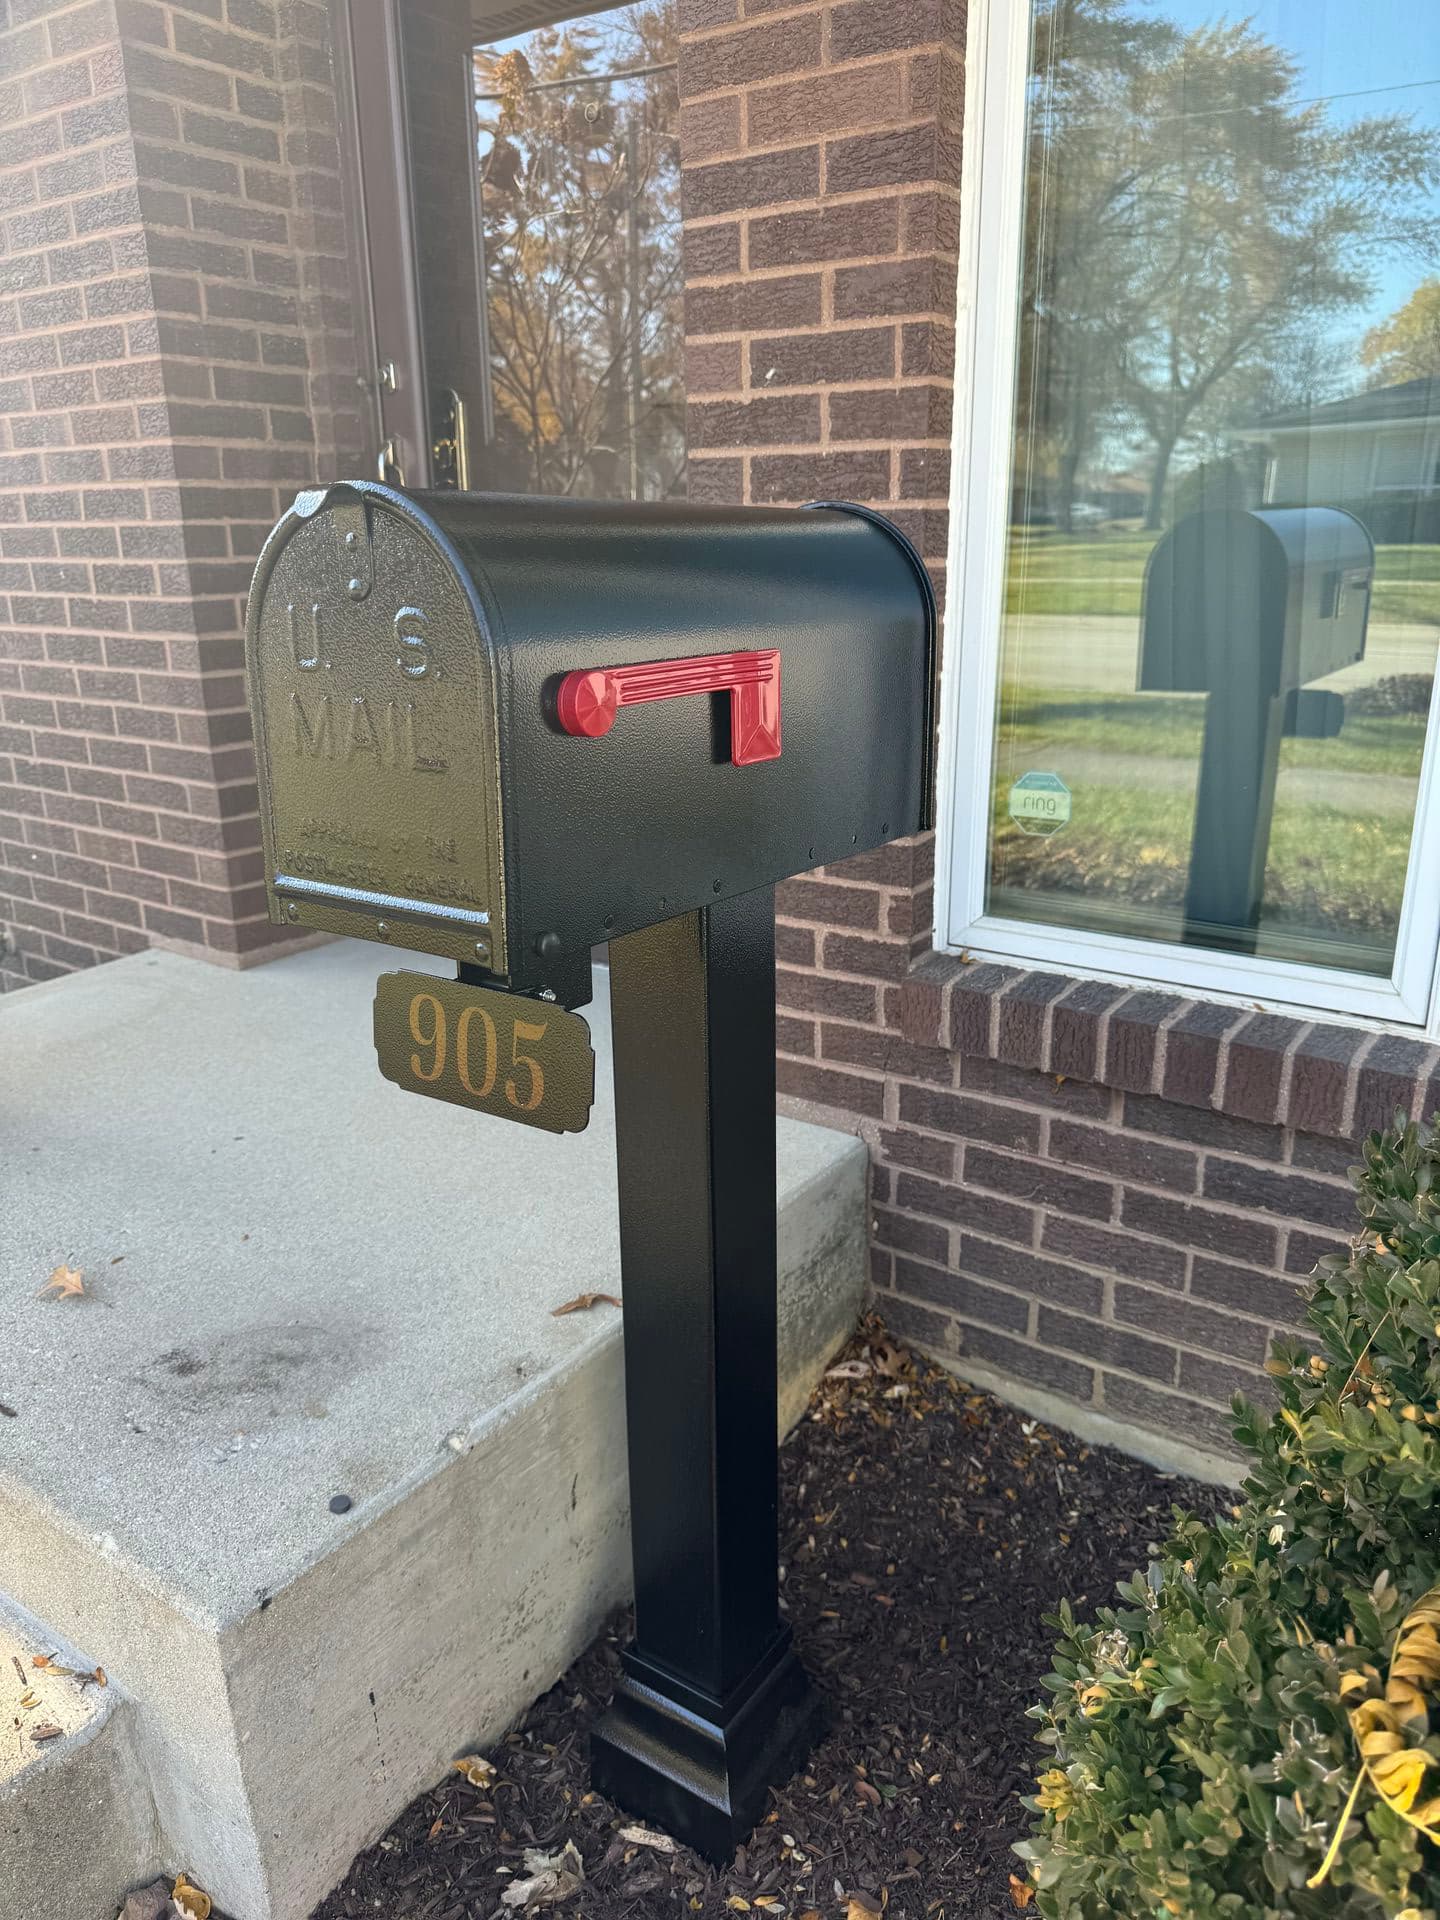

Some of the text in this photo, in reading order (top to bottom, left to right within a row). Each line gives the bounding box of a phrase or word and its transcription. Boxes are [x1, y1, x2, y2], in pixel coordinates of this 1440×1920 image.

[290, 692, 450, 774] MAIL
[1023, 792, 1056, 816] ring
[409, 993, 548, 1111] 905
